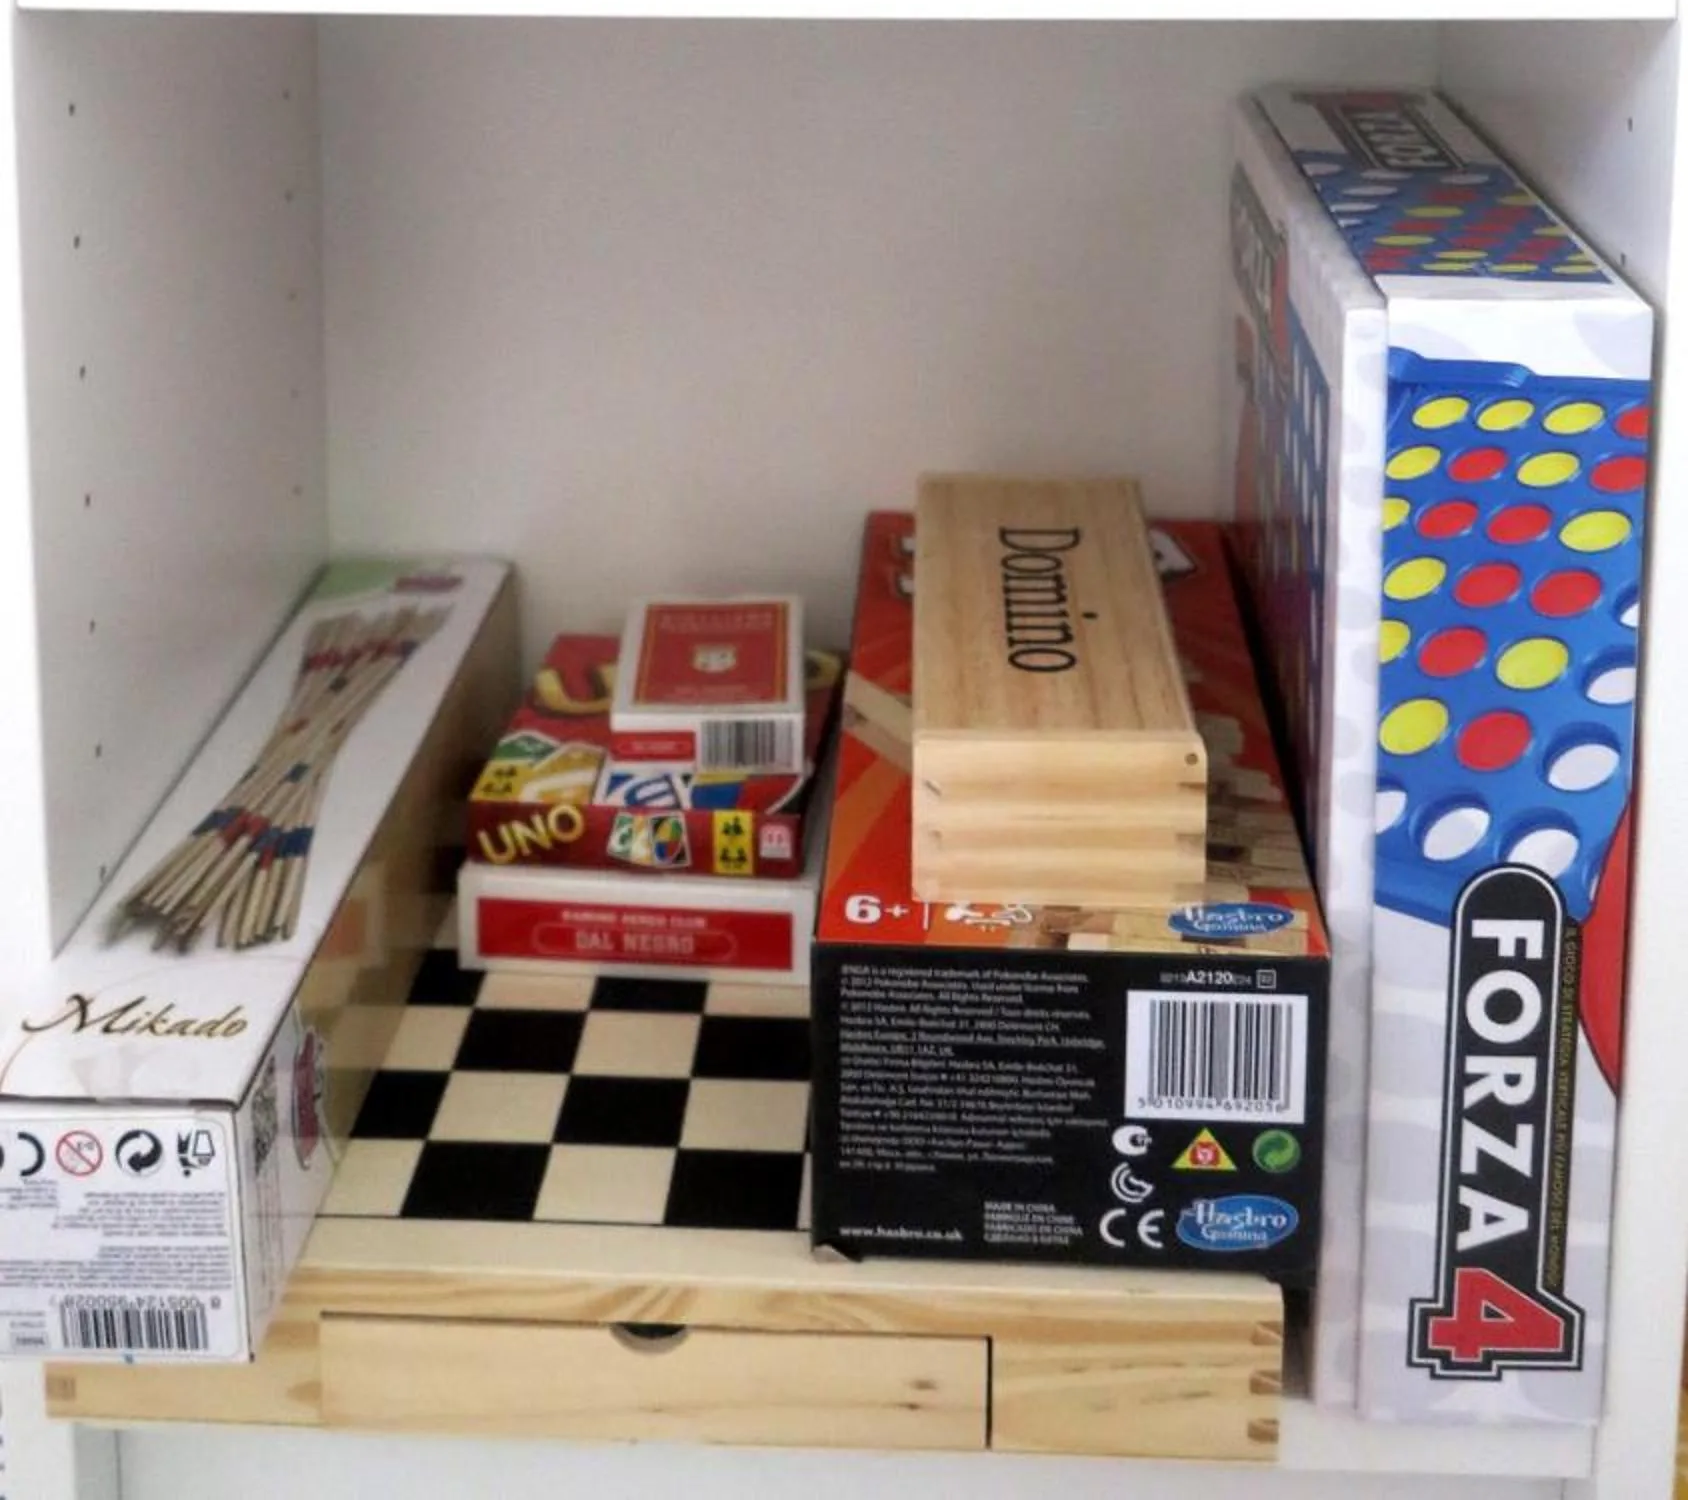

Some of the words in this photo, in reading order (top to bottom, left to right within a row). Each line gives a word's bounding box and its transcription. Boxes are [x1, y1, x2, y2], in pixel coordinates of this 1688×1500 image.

[999, 527, 1098, 672] Domino
[477, 804, 584, 864] UNO
[845, 895, 908, 924] 6+
[21, 993, 248, 1039] Mikado
[1455, 919, 1545, 1251] FORZA
[1181, 1201, 1287, 1231] Hasbro
[1428, 1266, 1565, 1362] 4
